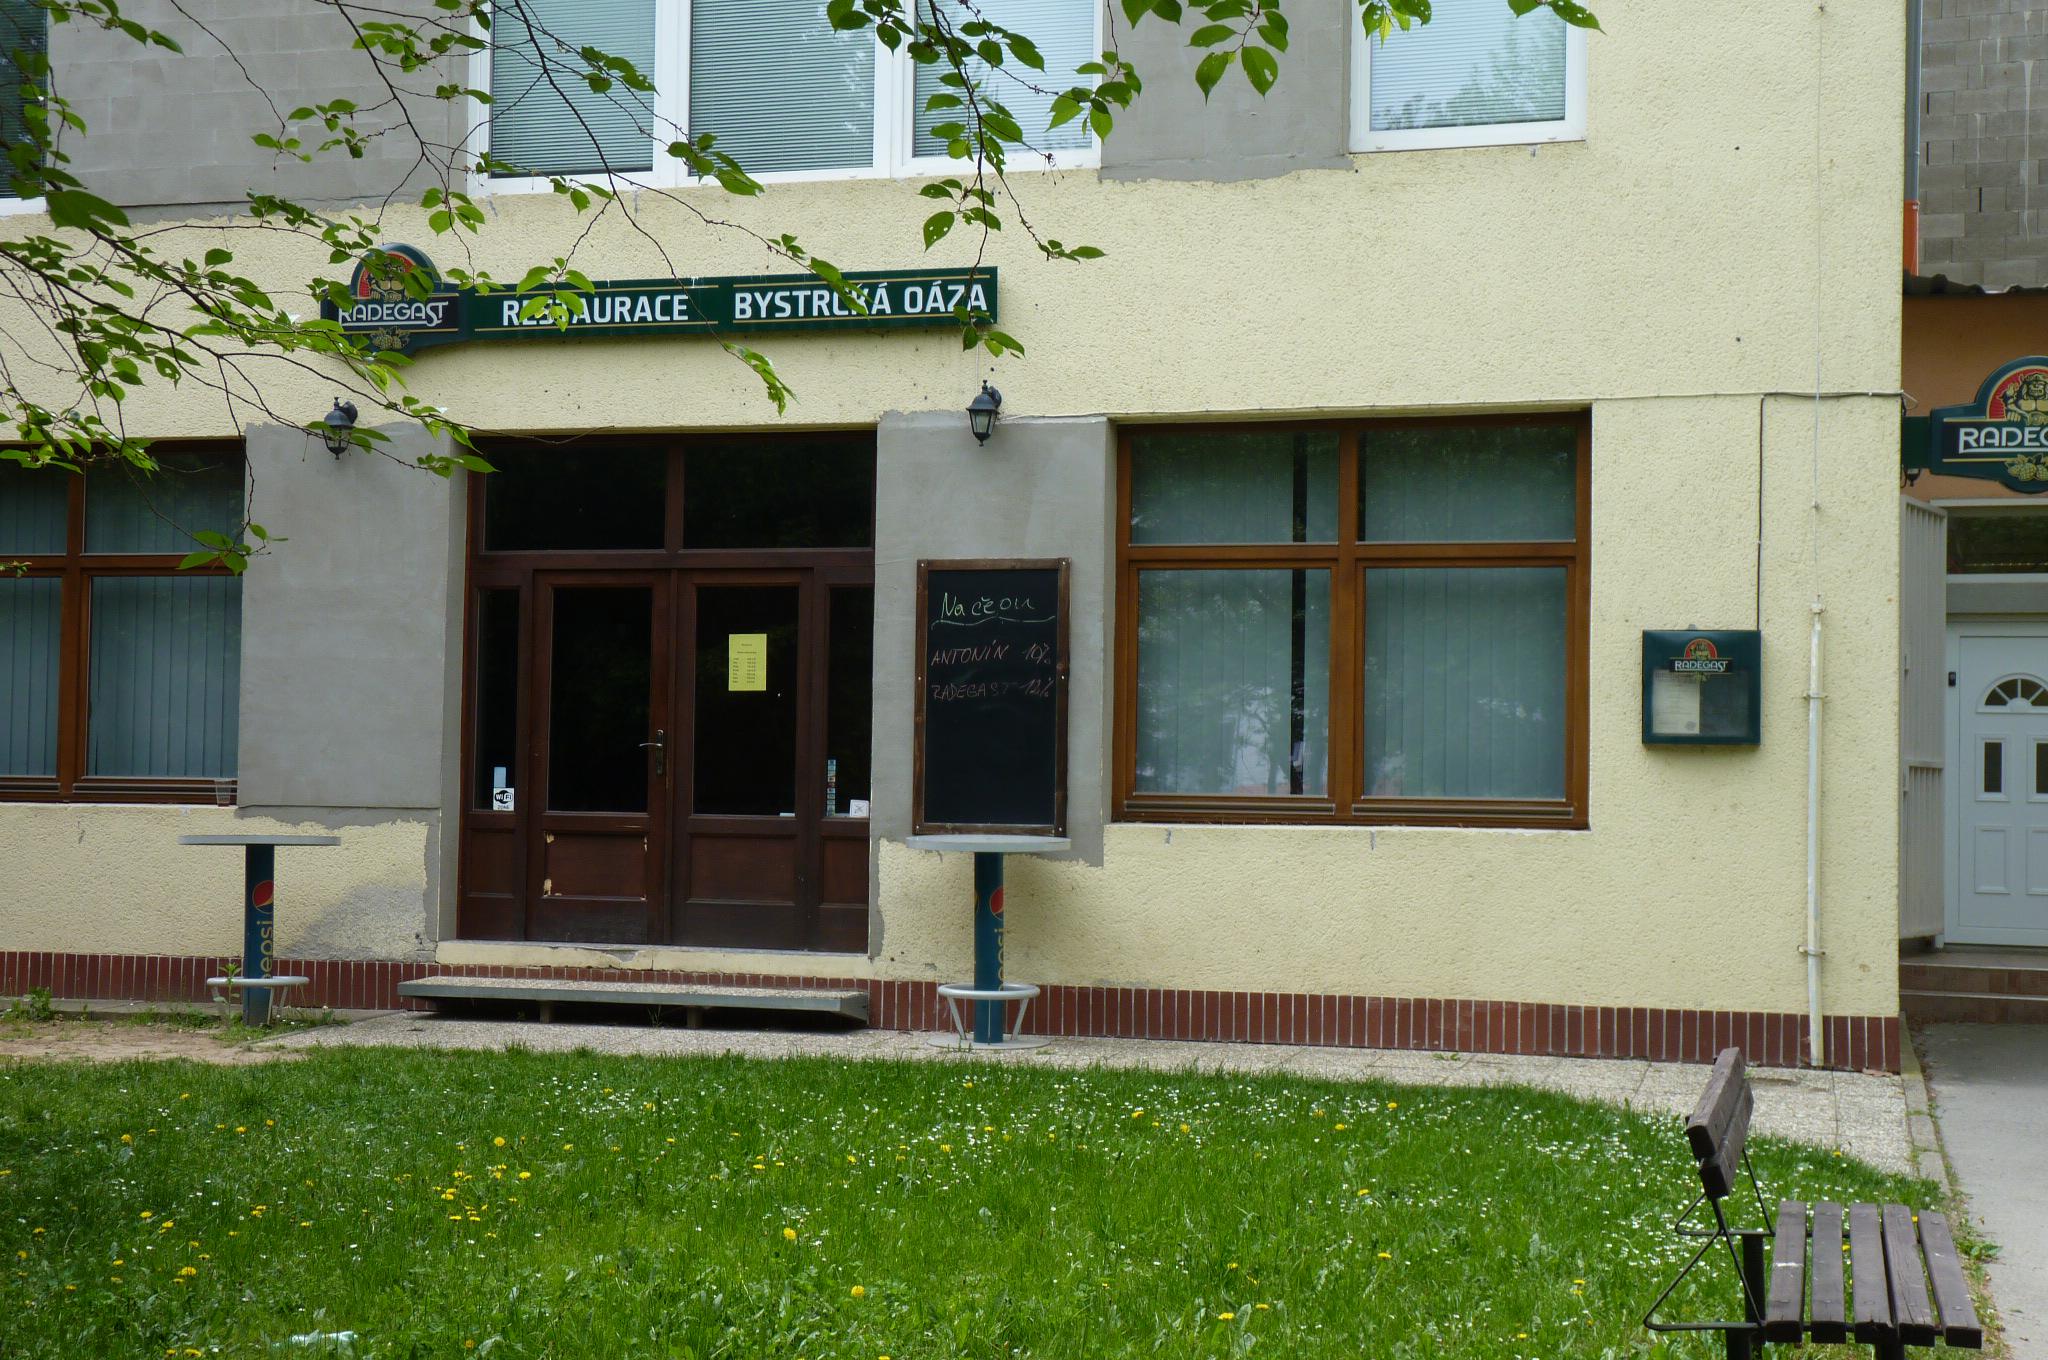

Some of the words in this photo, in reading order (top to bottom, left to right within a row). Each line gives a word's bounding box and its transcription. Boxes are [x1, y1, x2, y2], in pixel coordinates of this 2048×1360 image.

[502, 294, 689, 326] RAURACE
[903, 280, 988, 314] OÁZA
[941, 592, 966, 618] Na
[930, 639, 1010, 666] ANTONÍN
[1674, 660, 1729, 672] RADEGAST
